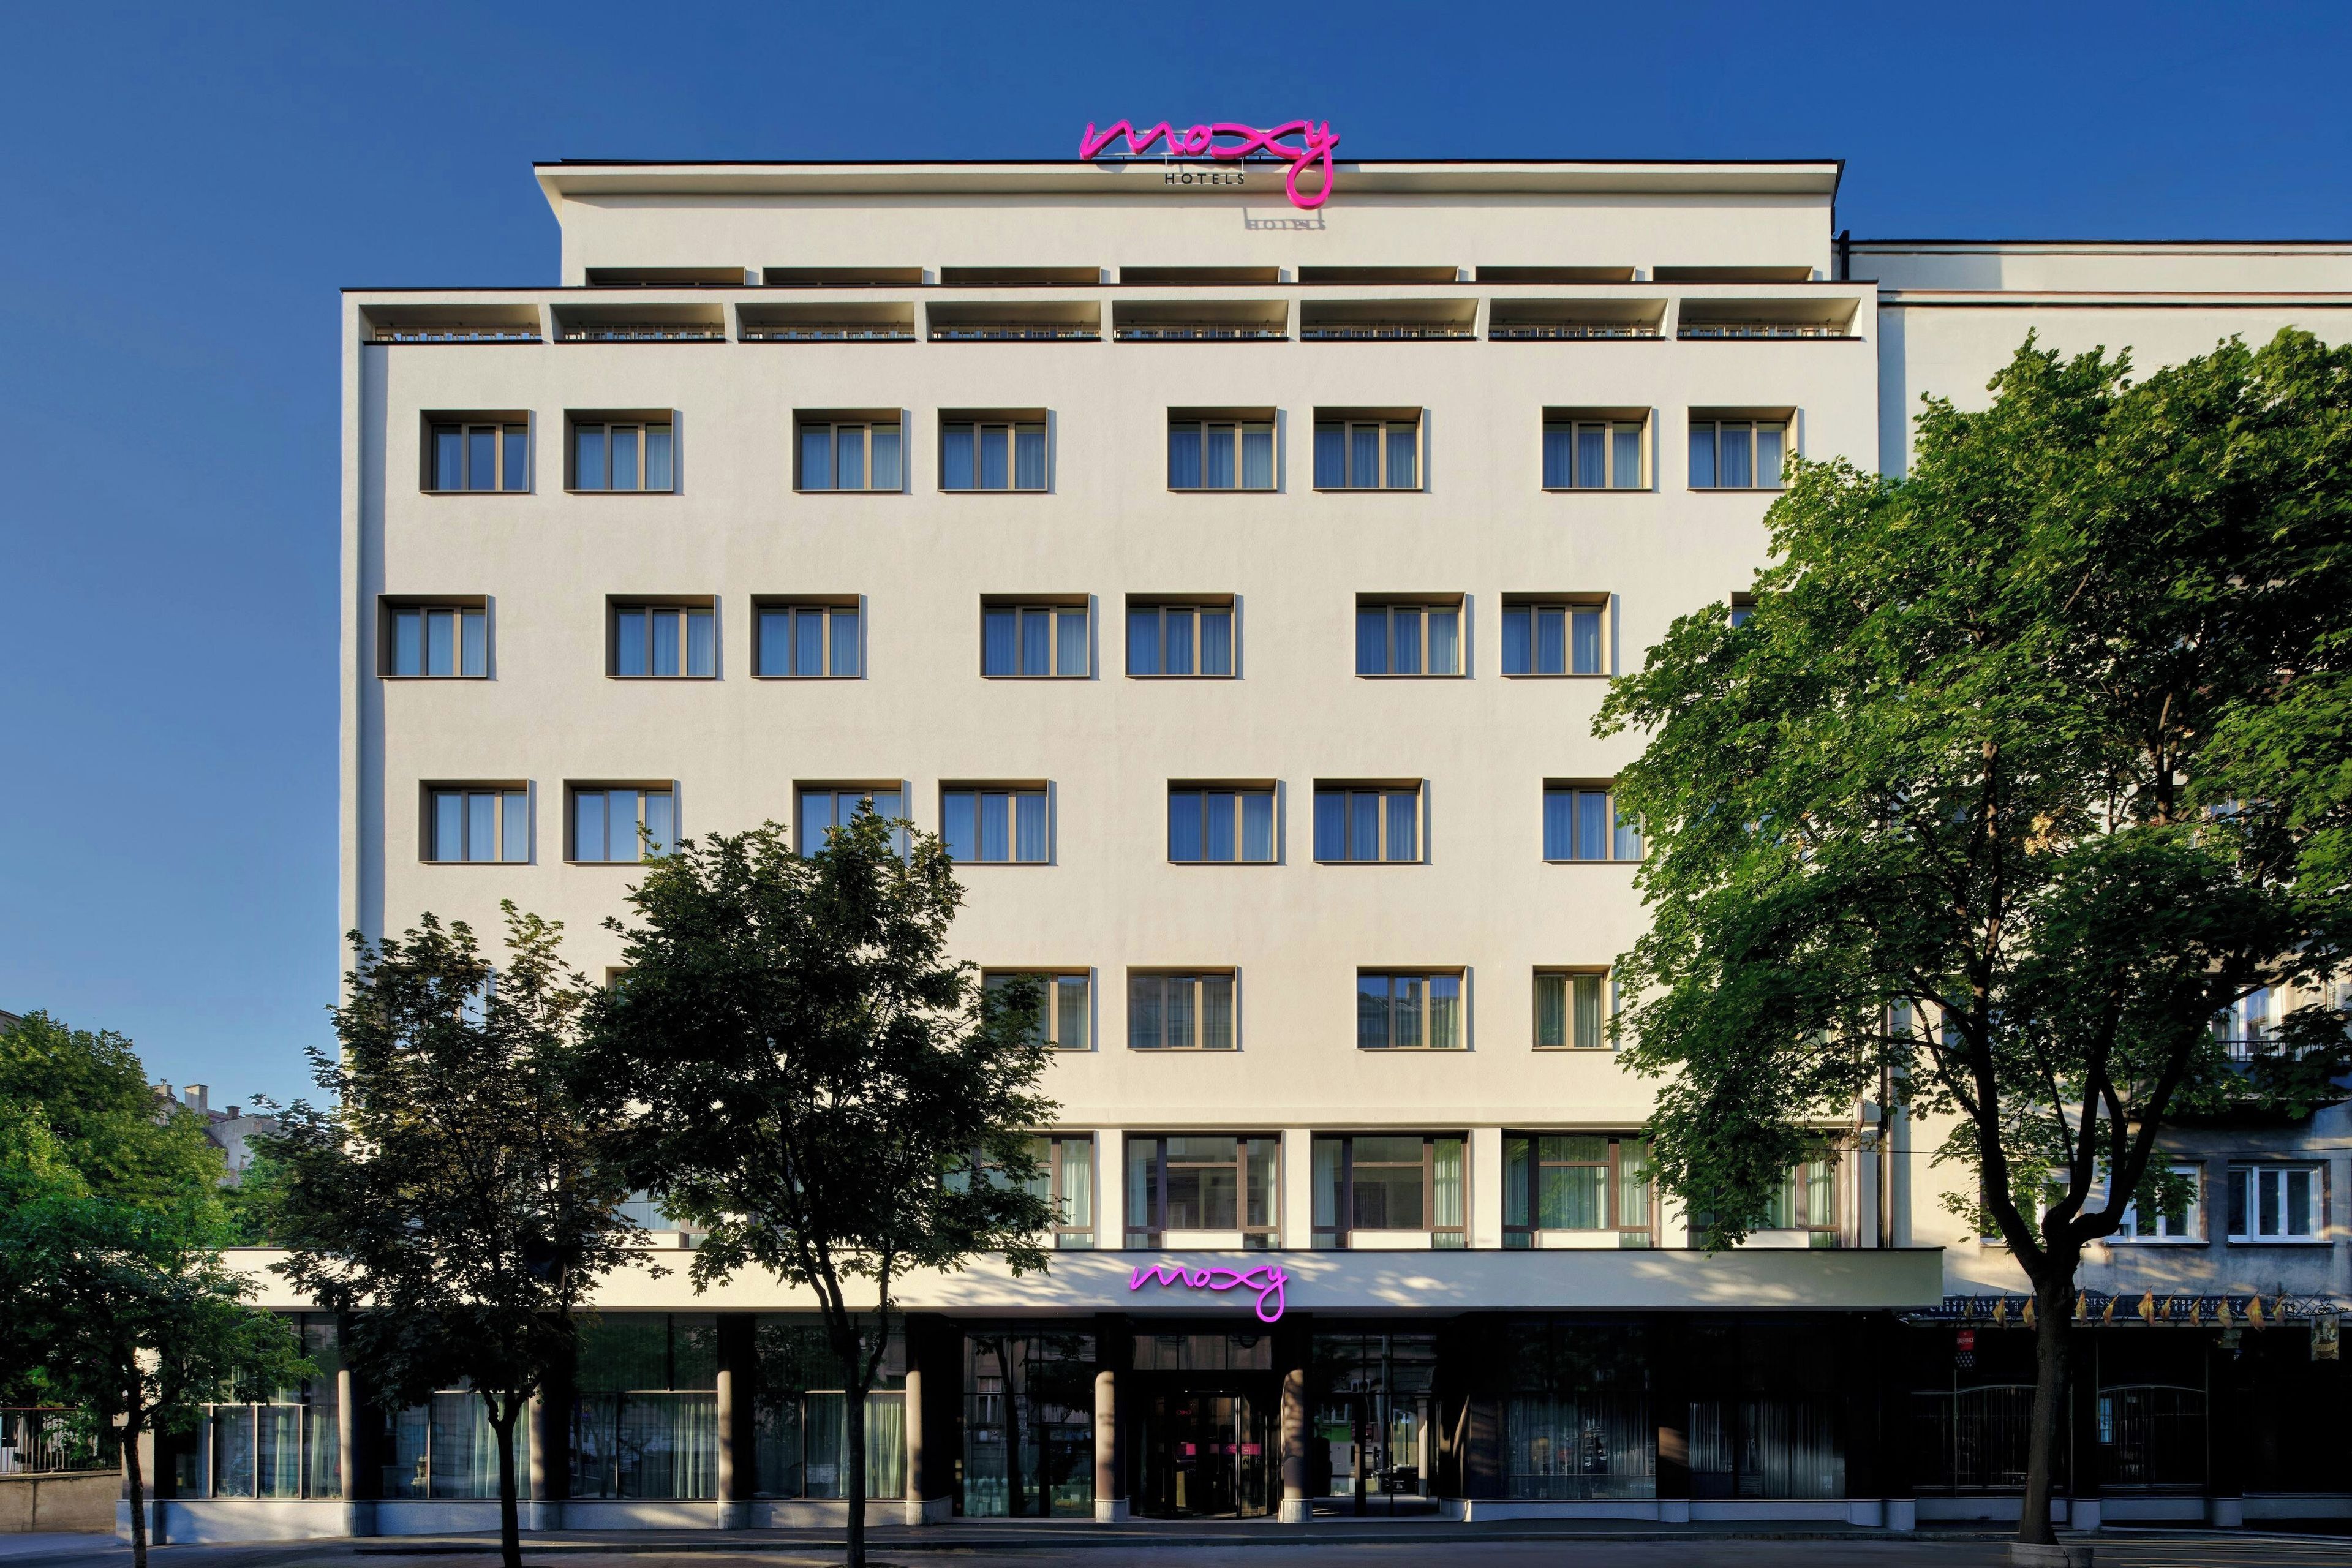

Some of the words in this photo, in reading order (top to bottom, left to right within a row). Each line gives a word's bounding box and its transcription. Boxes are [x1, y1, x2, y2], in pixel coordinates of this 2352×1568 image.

[1079, 120, 1340, 210] moxy
[1165, 173, 1244, 184] HOTELS
[1130, 1265, 1287, 1322] moxy
